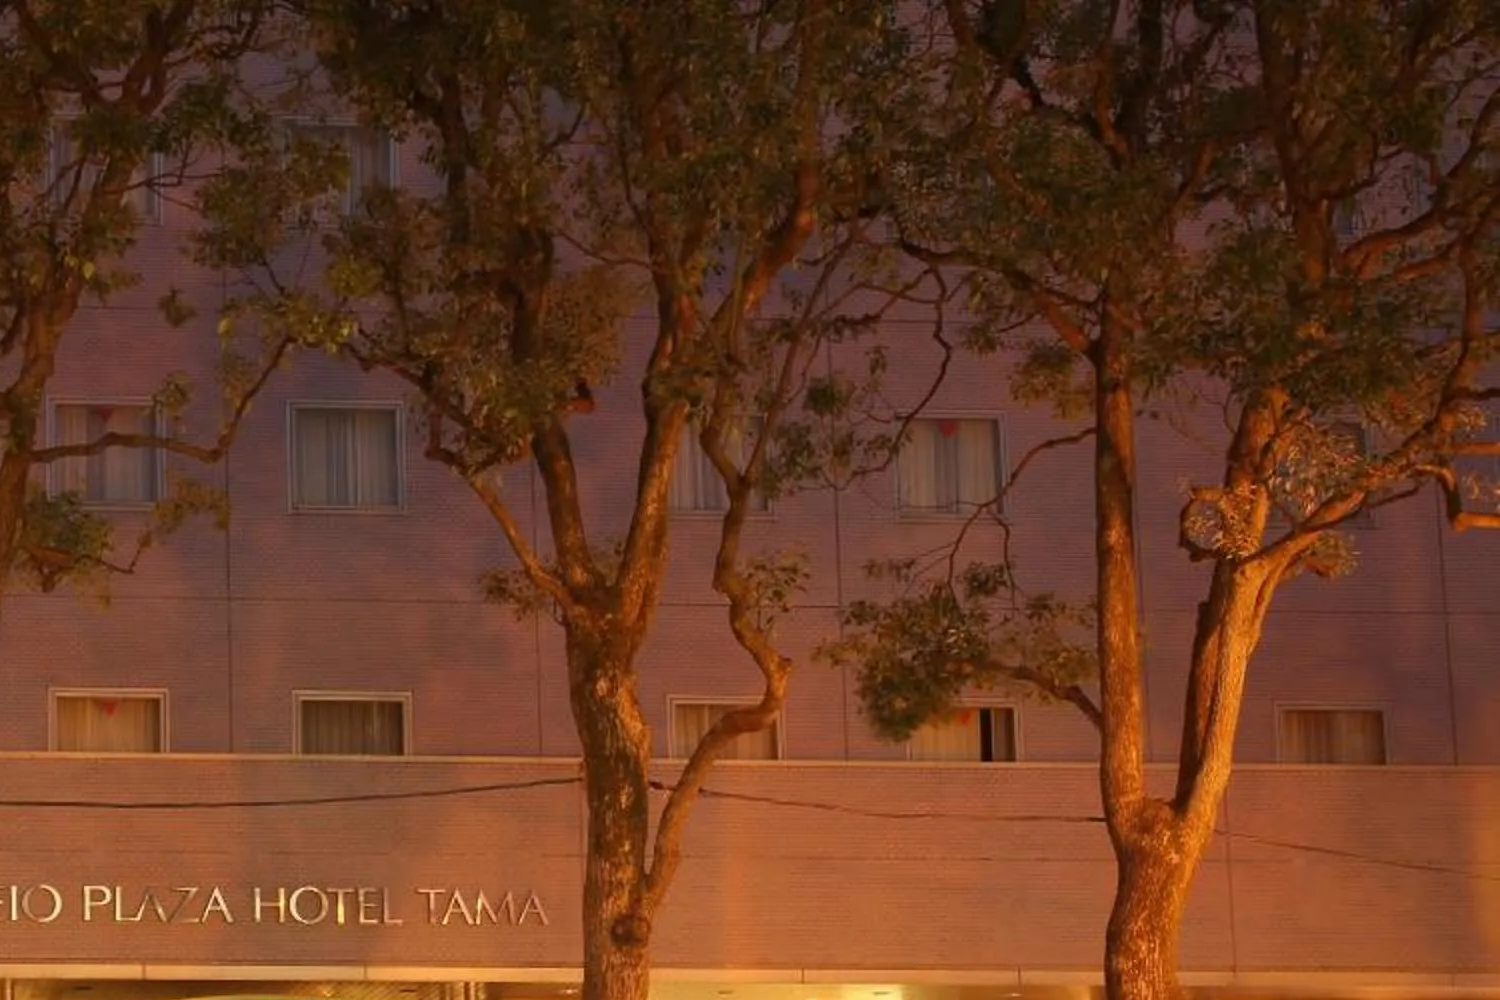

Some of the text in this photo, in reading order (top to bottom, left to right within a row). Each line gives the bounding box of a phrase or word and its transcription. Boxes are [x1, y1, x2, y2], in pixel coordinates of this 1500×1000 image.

[83, 885, 235, 924] PLAZA
[253, 887, 404, 925] HOTEL
[417, 888, 550, 926] TAMA
